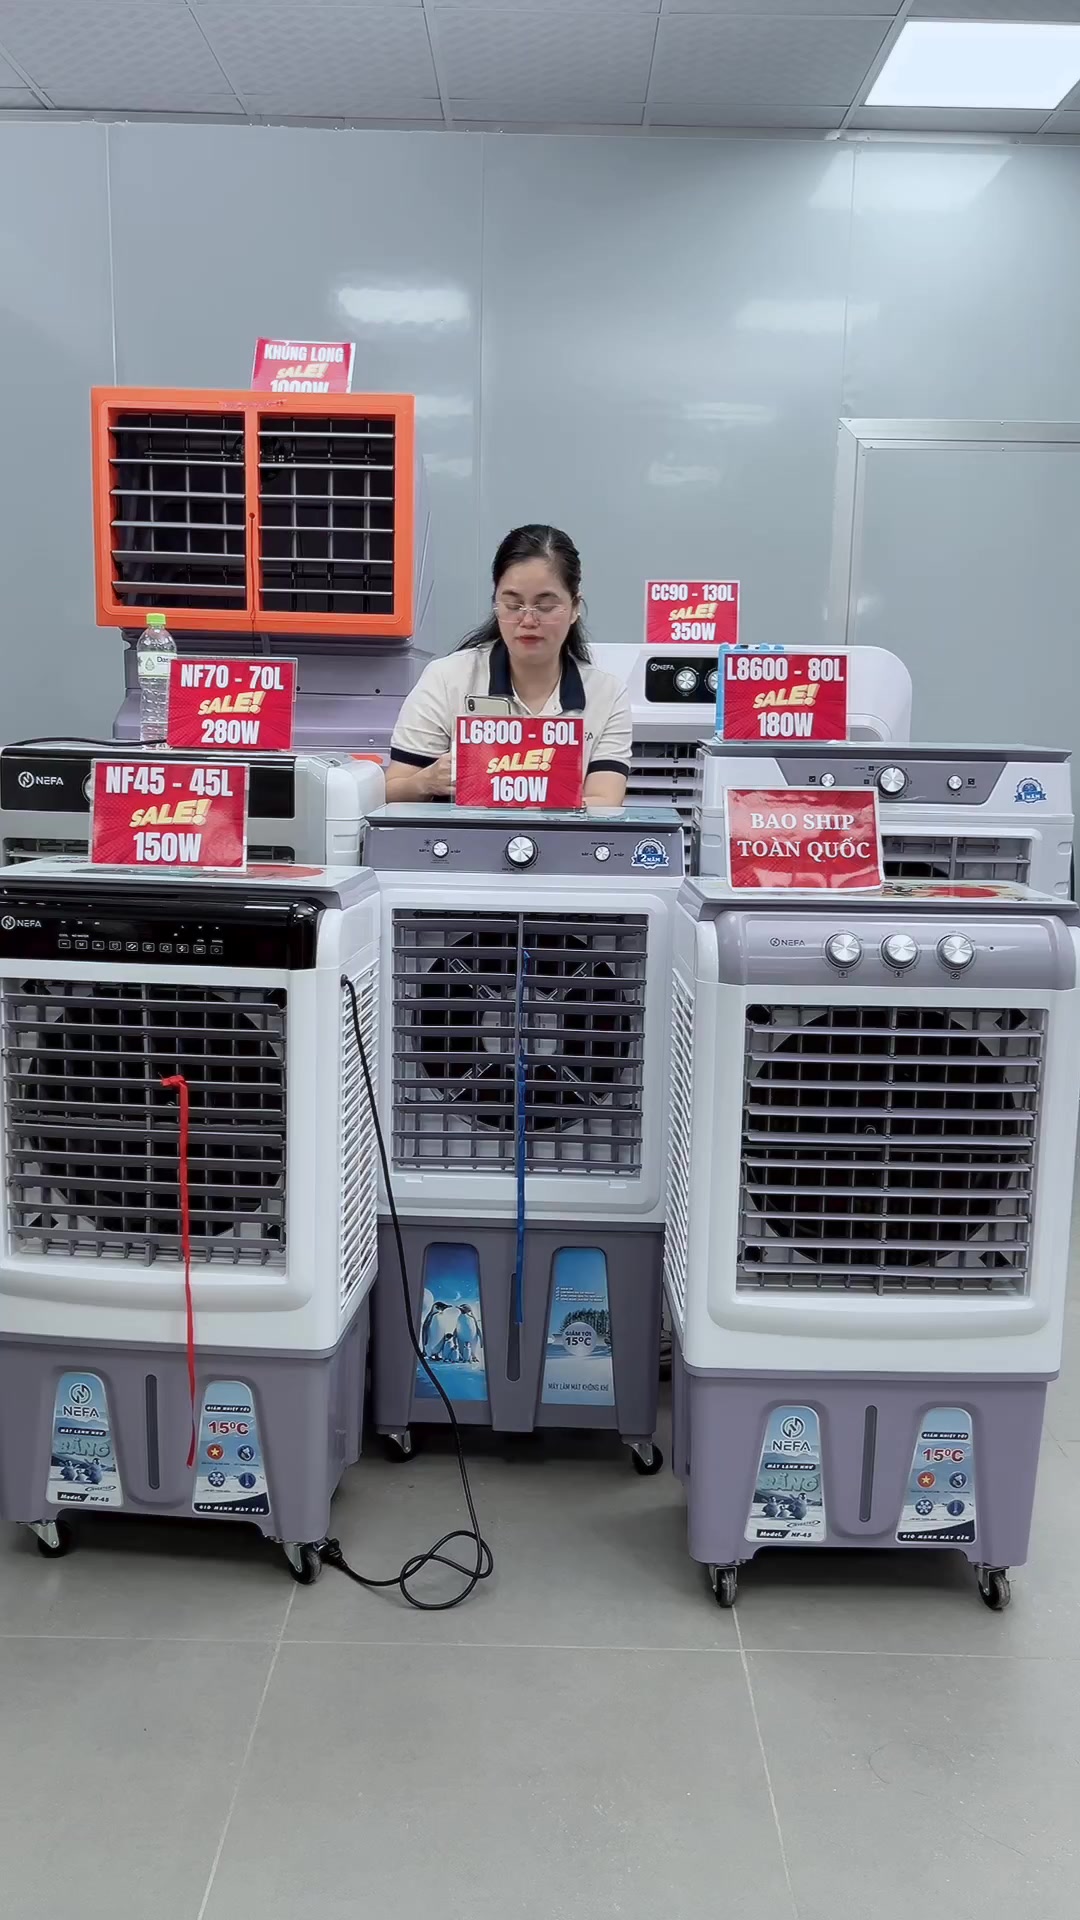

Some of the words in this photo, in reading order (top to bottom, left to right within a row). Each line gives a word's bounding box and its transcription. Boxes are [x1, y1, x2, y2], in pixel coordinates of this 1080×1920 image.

[264, 341, 308, 361] KHỦNG
[310, 346, 344, 363] LONG
[276, 362, 329, 379] SALE!
[270, 379, 330, 393] 1000W
[651, 584, 688, 601] CC90
[702, 584, 735, 602] 130L
[668, 602, 719, 621] SALE!
[670, 622, 717, 641] 350W
[180, 664, 229, 689] NF70
[249, 665, 284, 690] 70L
[726, 656, 789, 681] L8600
[807, 657, 845, 682] 80L
[197, 690, 267, 716] SALE!
[752, 683, 821, 709] SALE!
[200, 719, 260, 745] 280W
[459, 719, 523, 745] L6800
[542, 721, 579, 746] 60L
[757, 711, 814, 737] 180W
[486, 747, 557, 774] SALE!
[35, 776, 64, 786] NEFA
[105, 766, 166, 795] NF45
[189, 768, 234, 797] 45L
[490, 775, 549, 803] 160W
[129, 798, 213, 828] SALE!
[750, 813, 797, 830] BAO
[803, 814, 855, 831] SHIP
[133, 831, 203, 863] 150W
[737, 836, 801, 858] TOÀN
[807, 836, 871, 863] QUỐC
[17, 919, 42, 928] NEFA
[781, 939, 806, 947] NEFA
[565, 1336, 592, 1347] 15°C
[63, 1405, 99, 1417] NEFA
[208, 1421, 249, 1435] 15°C
[772, 1440, 811, 1452] NEFA
[923, 1448, 964, 1462] 15°C
